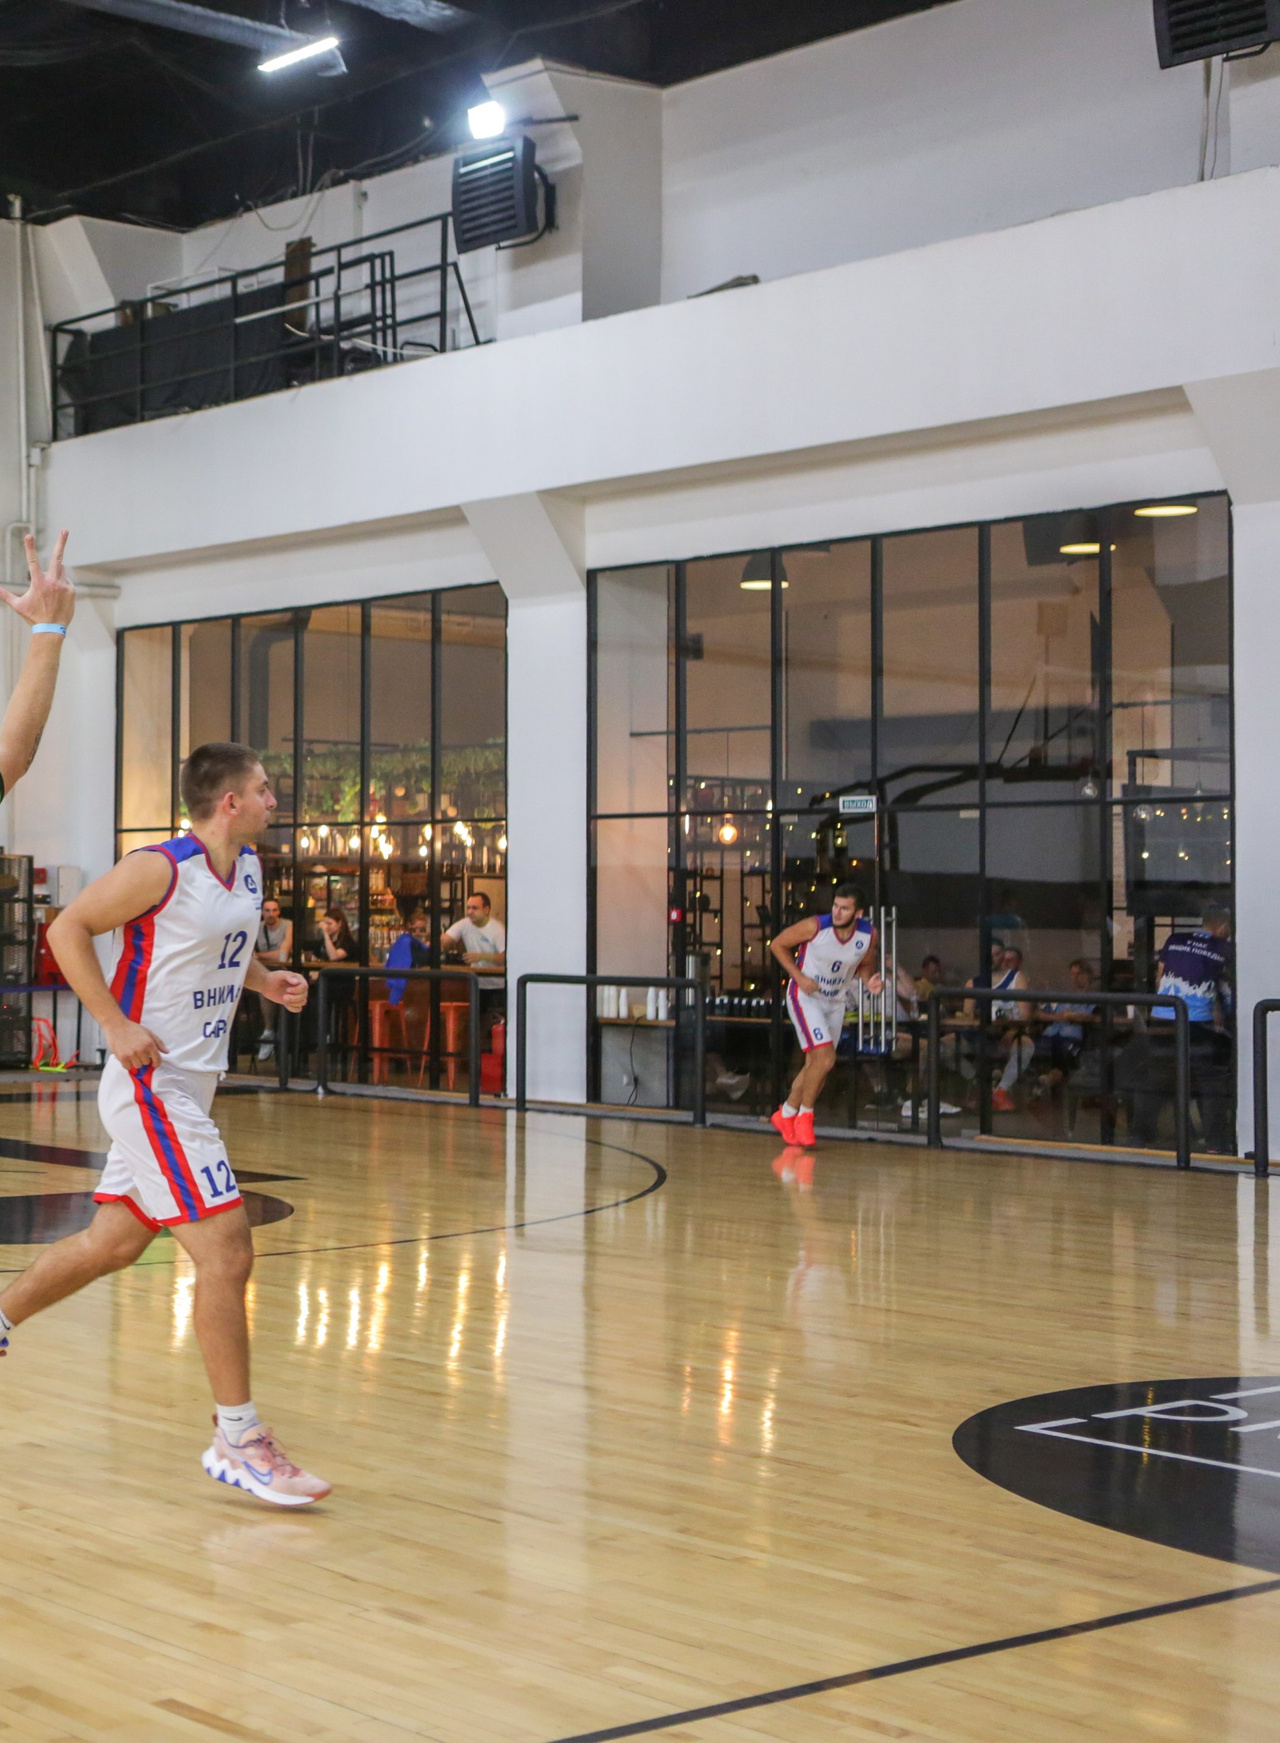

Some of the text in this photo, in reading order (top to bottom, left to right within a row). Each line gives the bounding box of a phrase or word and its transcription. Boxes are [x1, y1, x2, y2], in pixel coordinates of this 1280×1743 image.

[218, 930, 248, 970] 12
[831, 960, 843, 974] 6
[813, 1027, 824, 1041] 6
[201, 1160, 237, 1199] 12
